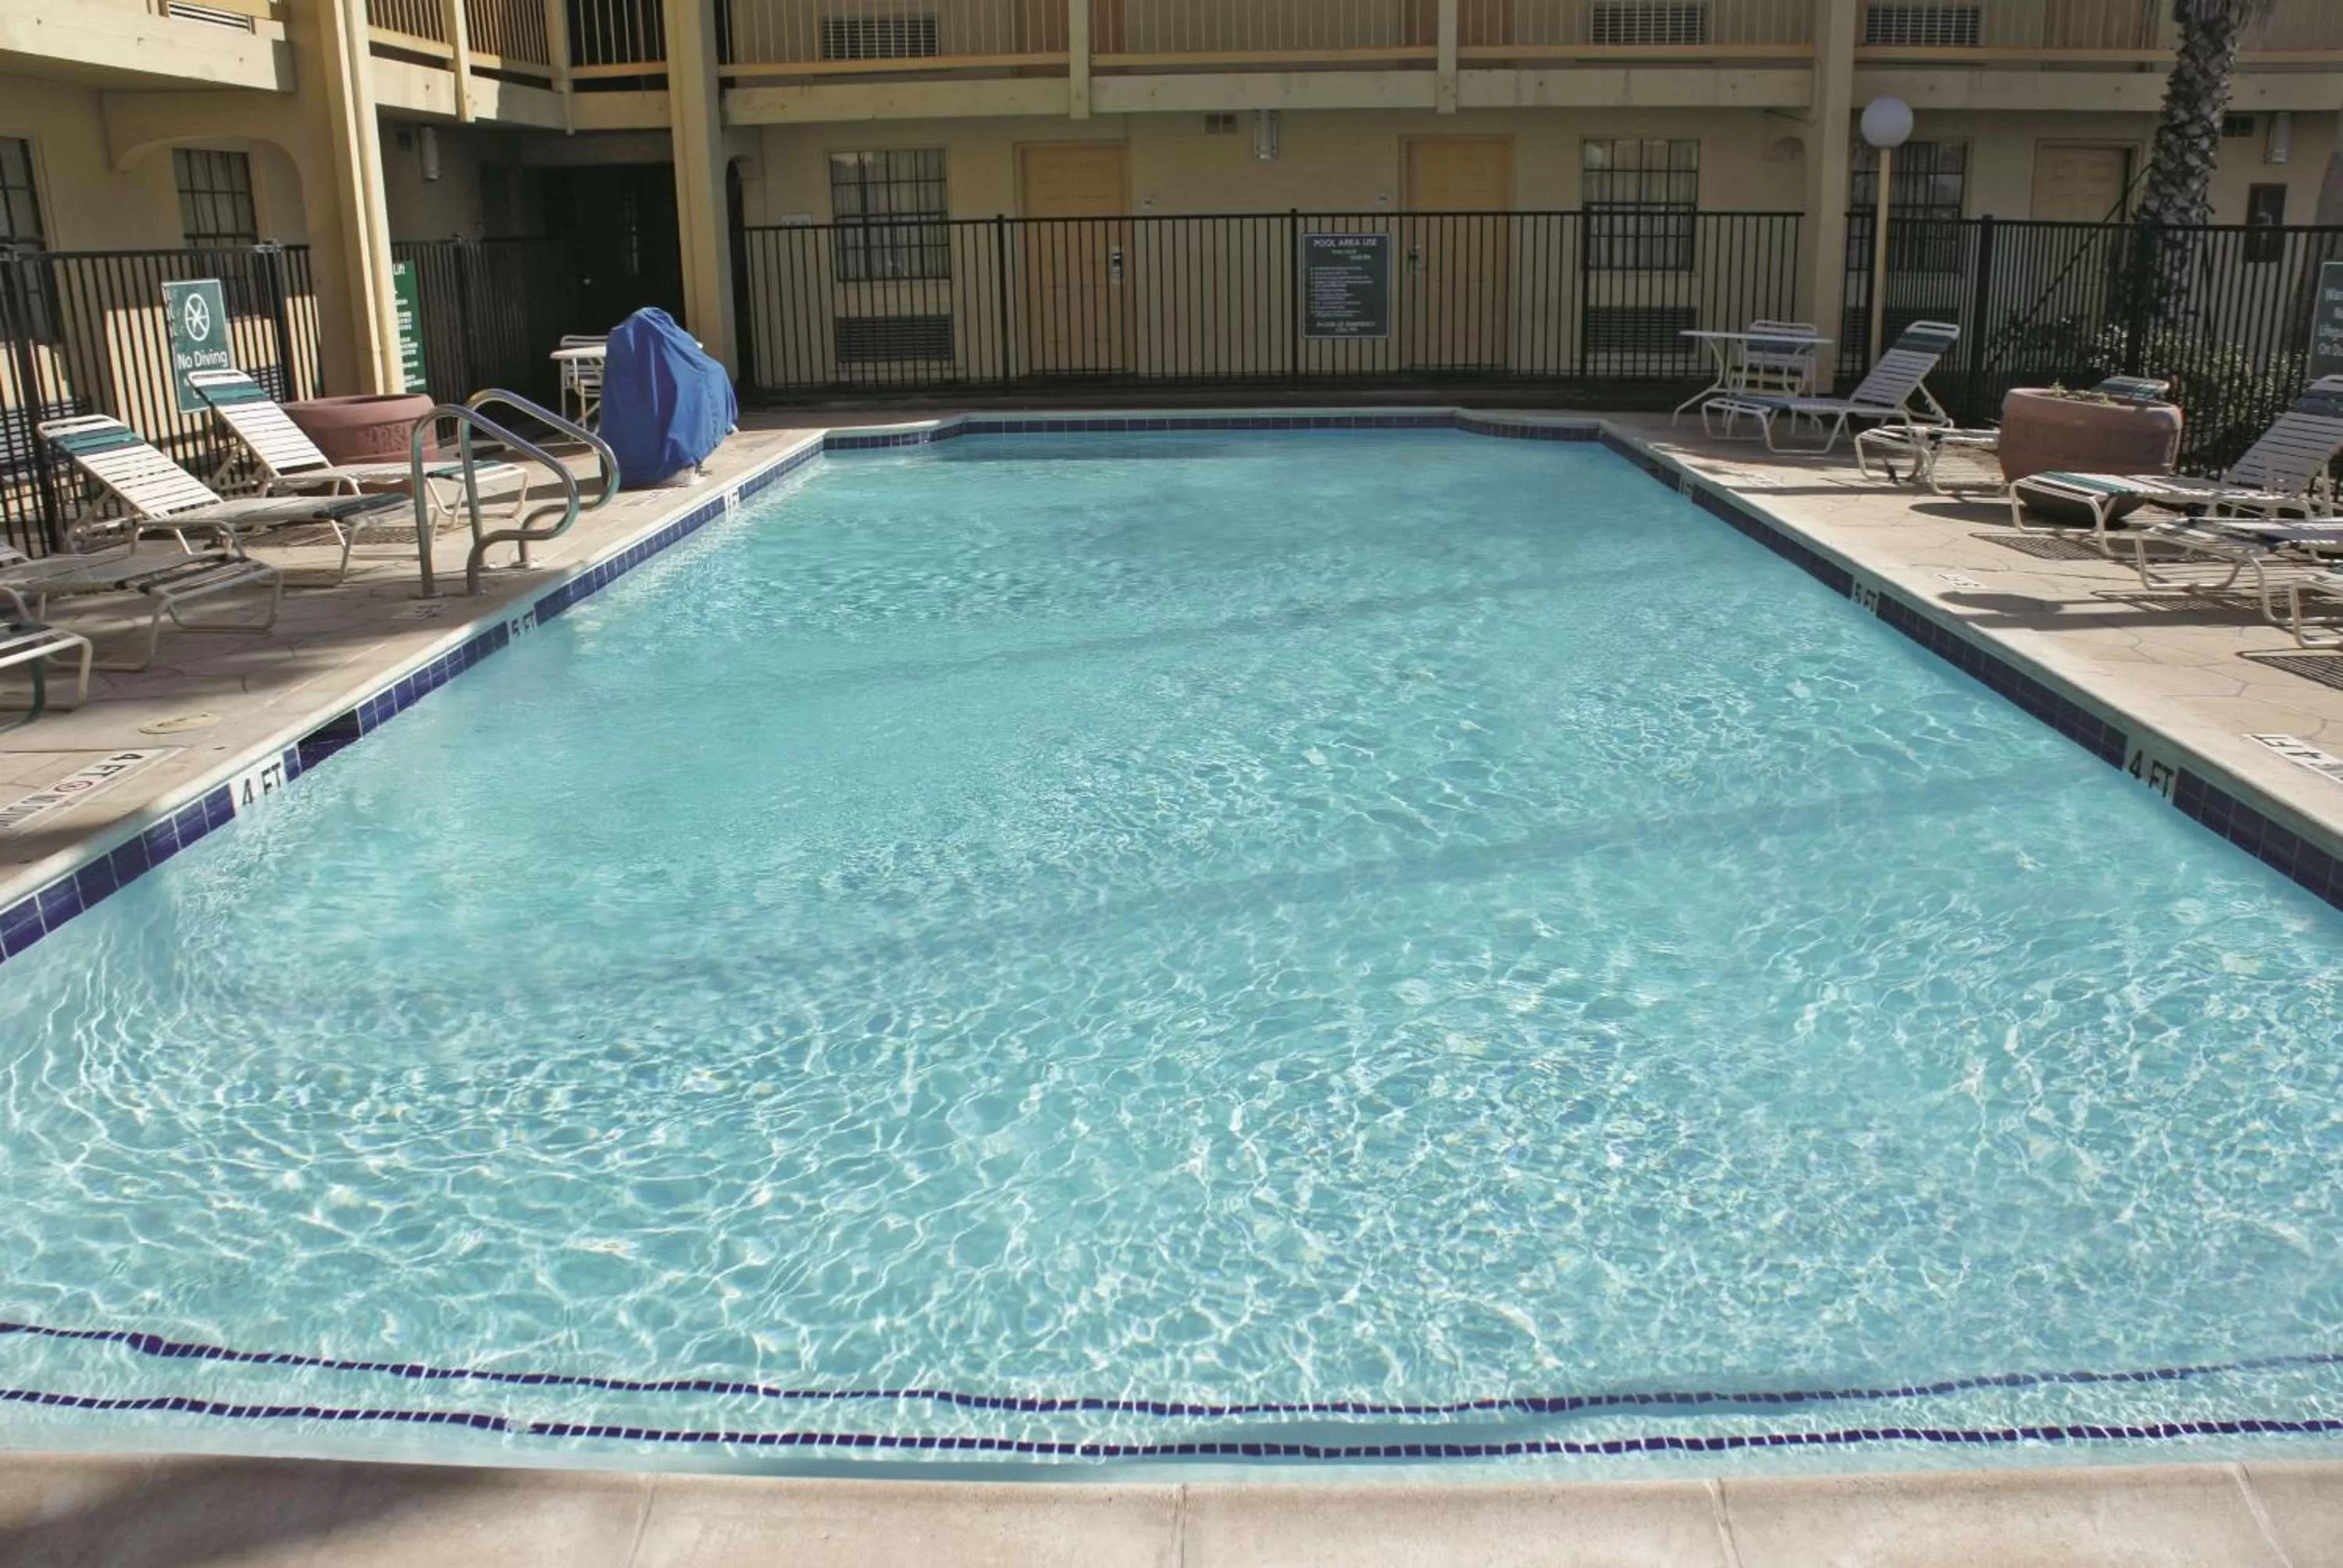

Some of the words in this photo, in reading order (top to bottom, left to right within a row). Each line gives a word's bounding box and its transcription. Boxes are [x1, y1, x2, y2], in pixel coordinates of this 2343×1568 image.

[1313, 238, 1336, 248] POOL
[1338, 237, 1360, 248] AREA
[177, 353, 192, 369] No
[195, 349, 228, 368] Diving
[78, 764, 127, 777] FT
[2127, 749, 2144, 780] 4
[2149, 758, 2174, 797] FT
[241, 778, 255, 807] 4
[260, 761, 283, 796] FT
